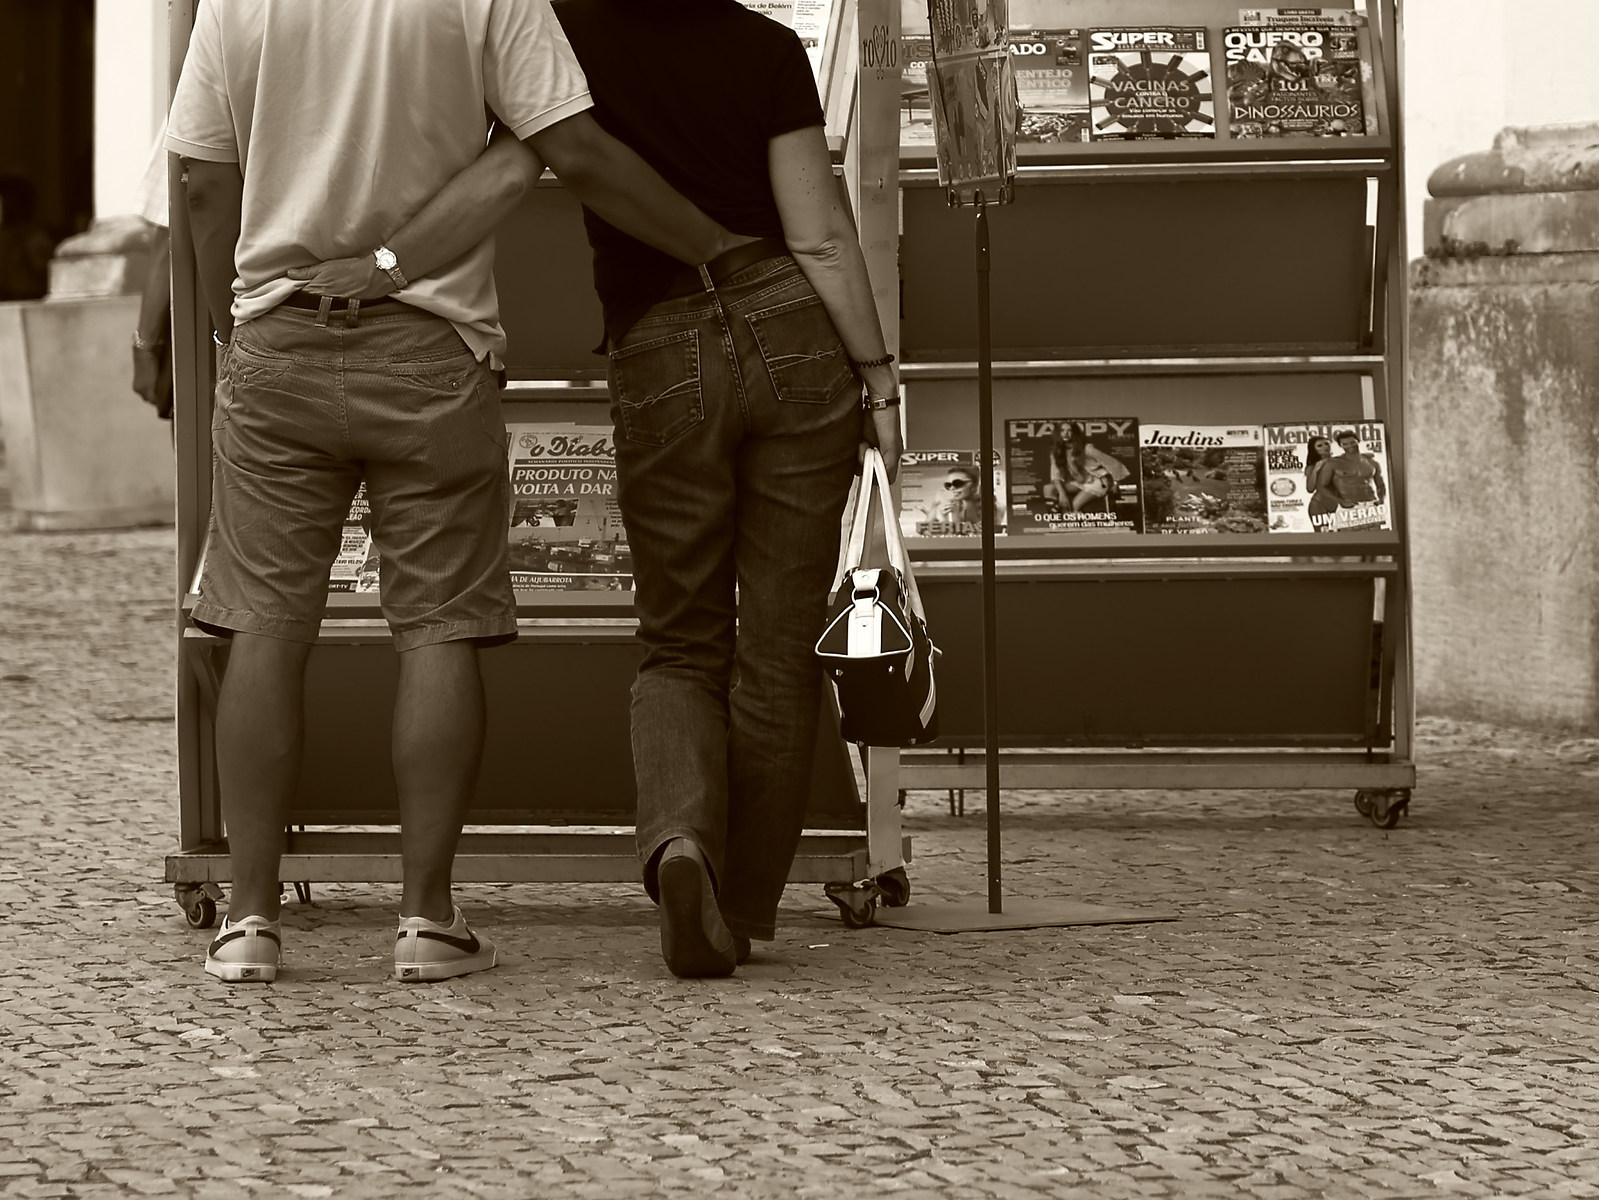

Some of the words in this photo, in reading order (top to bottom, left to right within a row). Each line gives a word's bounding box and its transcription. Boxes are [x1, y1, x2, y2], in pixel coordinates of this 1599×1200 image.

[1090, 31, 1175, 51] SUPER
[1225, 32, 1323, 49] QUERO
[1111, 80, 1190, 92] VACINAS
[1114, 97, 1190, 108] CANCRO
[1235, 104, 1358, 119] DINOSSAURIOS
[1144, 430, 1224, 446] Jardins
[900, 452, 960, 466] SUPER
[515, 469, 593, 480] PRODUTO
[513, 483, 559, 495] VOLTA
[563, 483, 575, 494] A
[580, 483, 613, 495] DAR
[1034, 513, 1042, 521] O
[1043, 513, 1062, 522] QUE
[1063, 513, 1076, 521] OS
[1077, 512, 1117, 520] HOMENS
[1049, 521, 1080, 529] querem
[1081, 519, 1096, 527] das
[1097, 519, 1134, 527] mulheres
